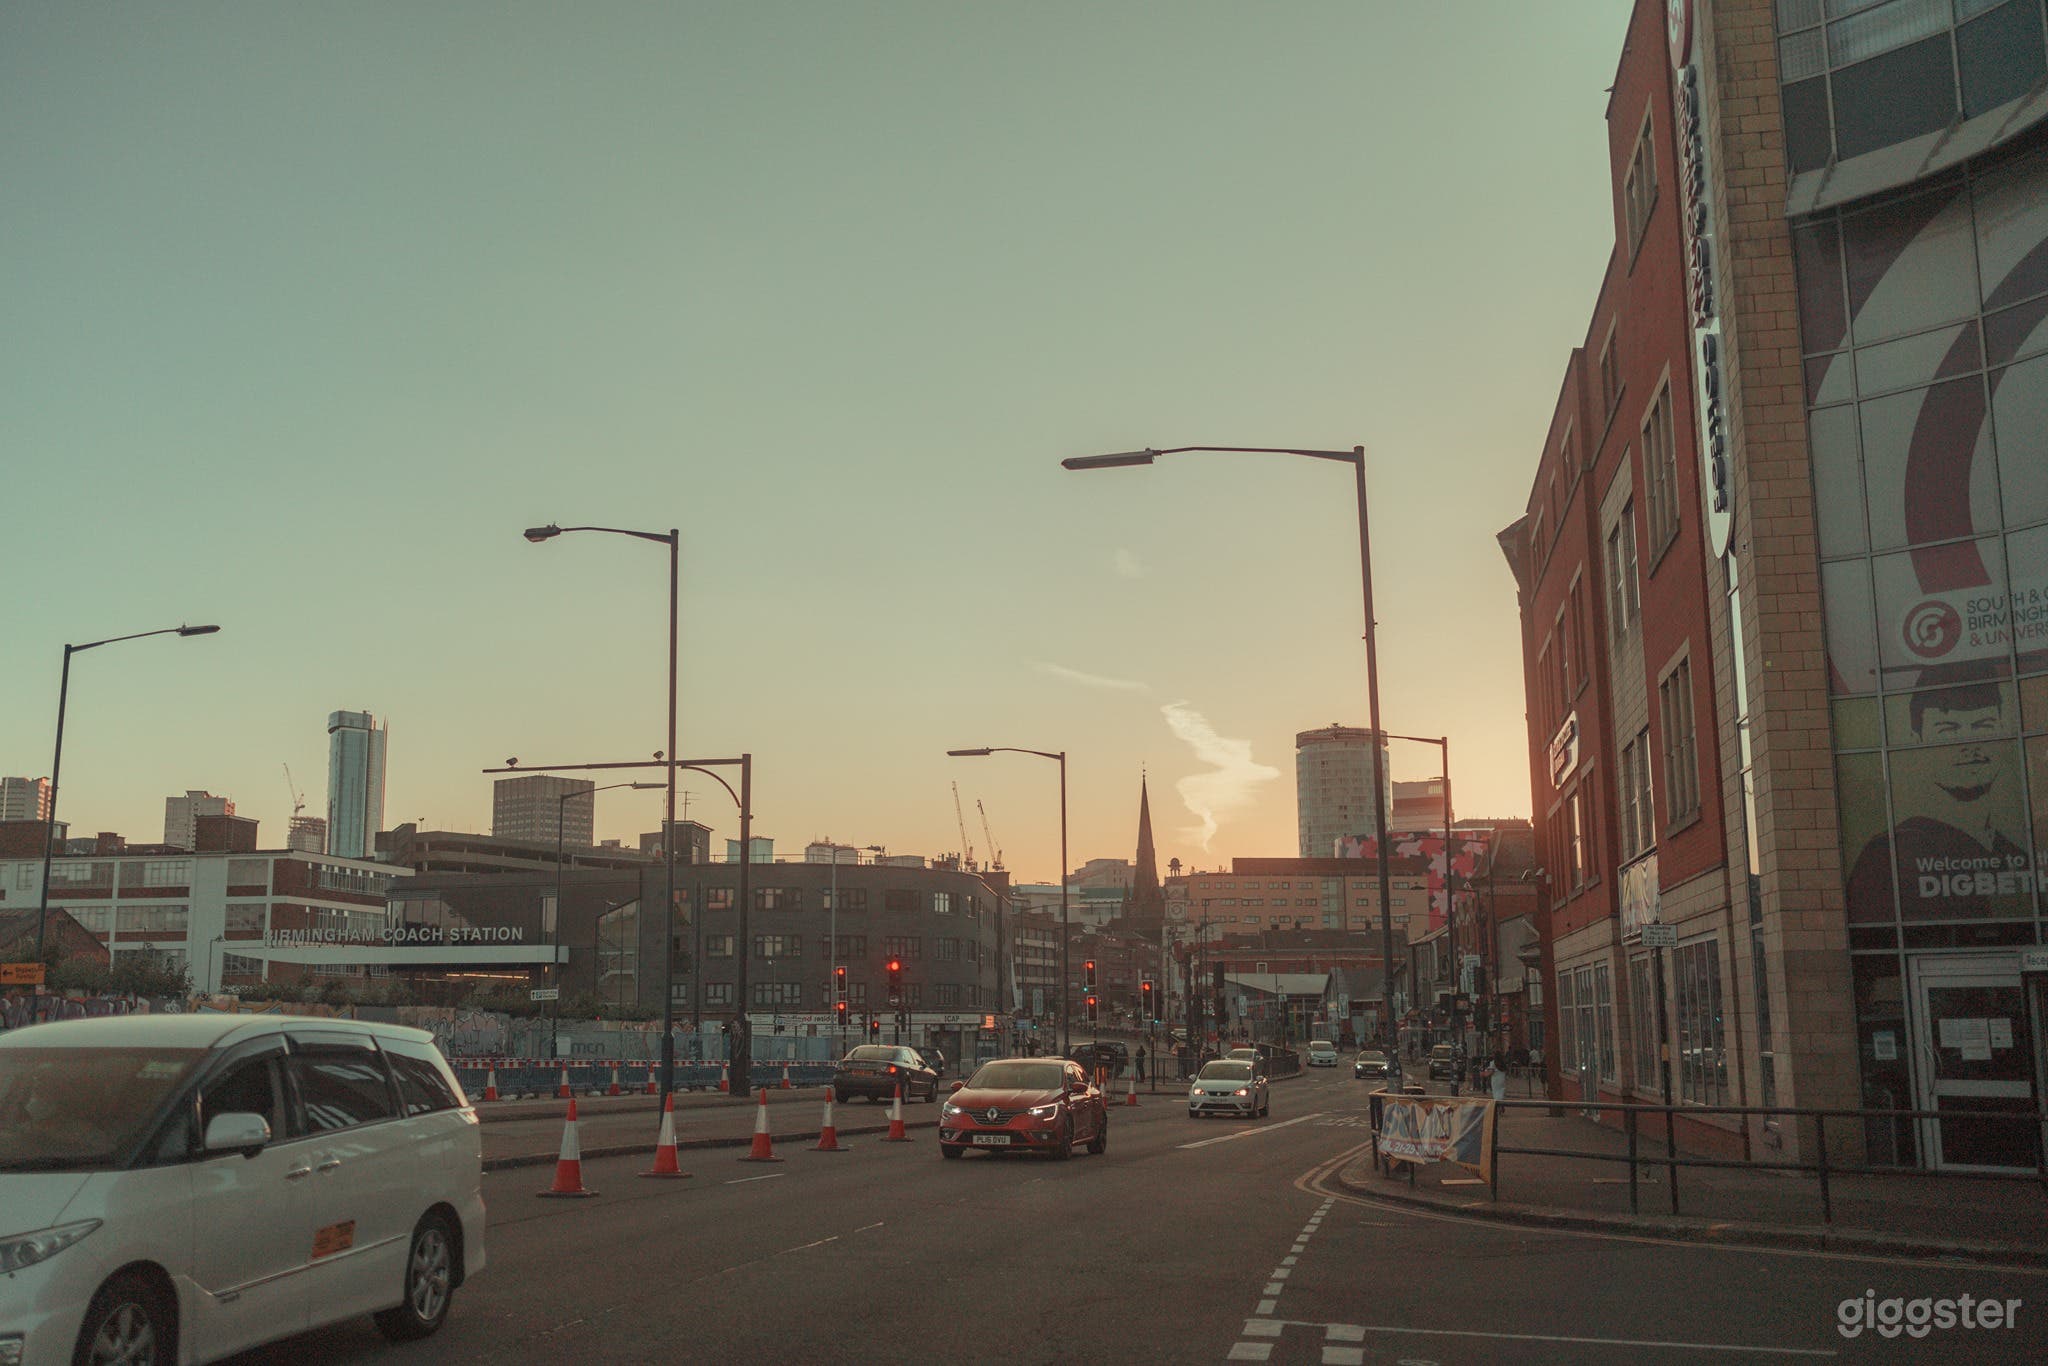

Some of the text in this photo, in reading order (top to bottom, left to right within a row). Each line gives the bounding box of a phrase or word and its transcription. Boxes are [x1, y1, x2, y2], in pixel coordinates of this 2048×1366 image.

[1702, 333, 1727, 513] COLLEGE
[2029, 588, 2040, 604] &
[1968, 606, 2048, 631] BIRMNGH
[1970, 622, 2048, 647] & UNVER
[1916, 856, 2001, 872] Welcome
[2006, 854, 2025, 868] to
[264, 926, 524, 945] BIRMINGHAM COACH STATION
